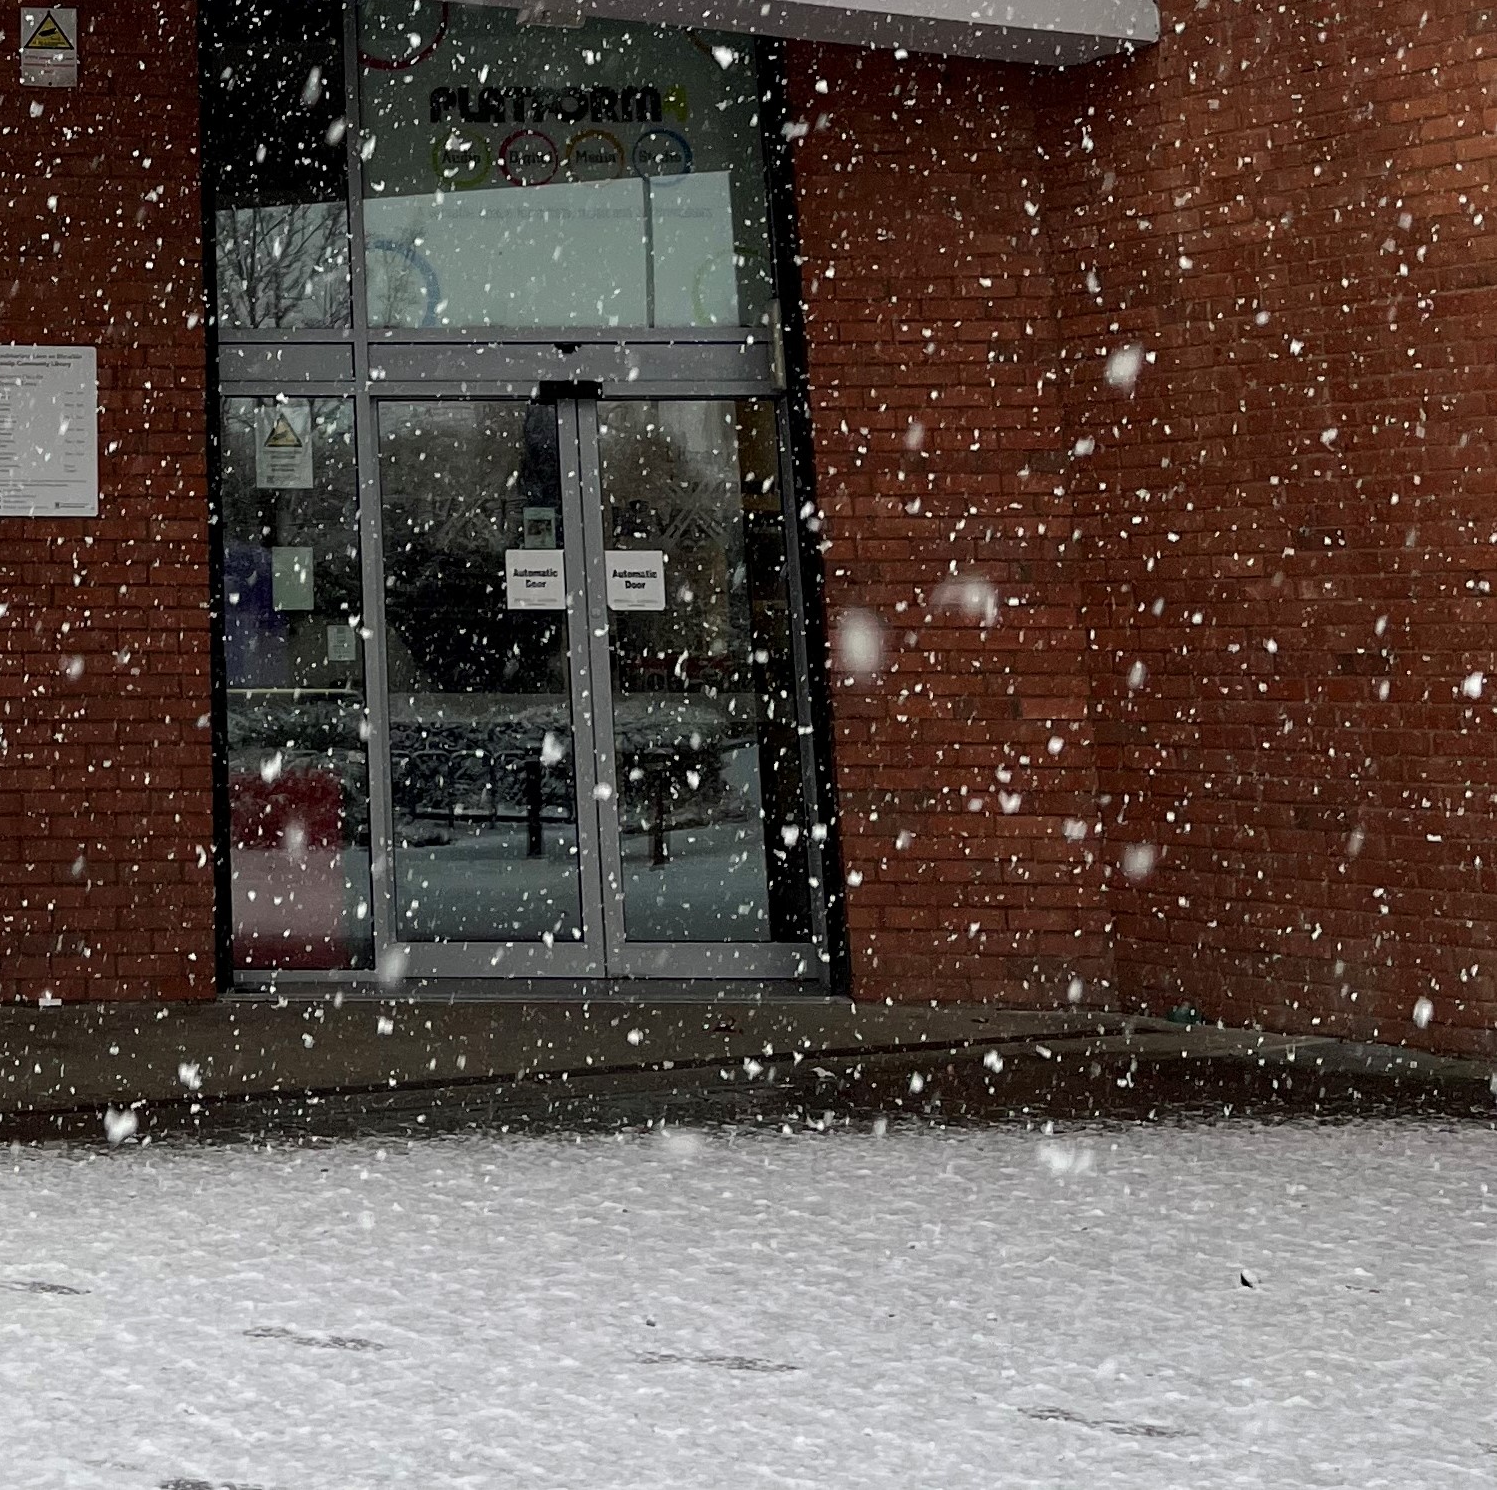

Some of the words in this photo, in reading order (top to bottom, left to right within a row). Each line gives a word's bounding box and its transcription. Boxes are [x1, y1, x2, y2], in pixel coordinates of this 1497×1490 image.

[442, 150, 481, 164] Audio
[575, 150, 616, 163] Media
[512, 568, 558, 577] Automatic
[612, 569, 658, 579] Automatic
[525, 579, 547, 588] Door
[625, 580, 646, 589] Door
